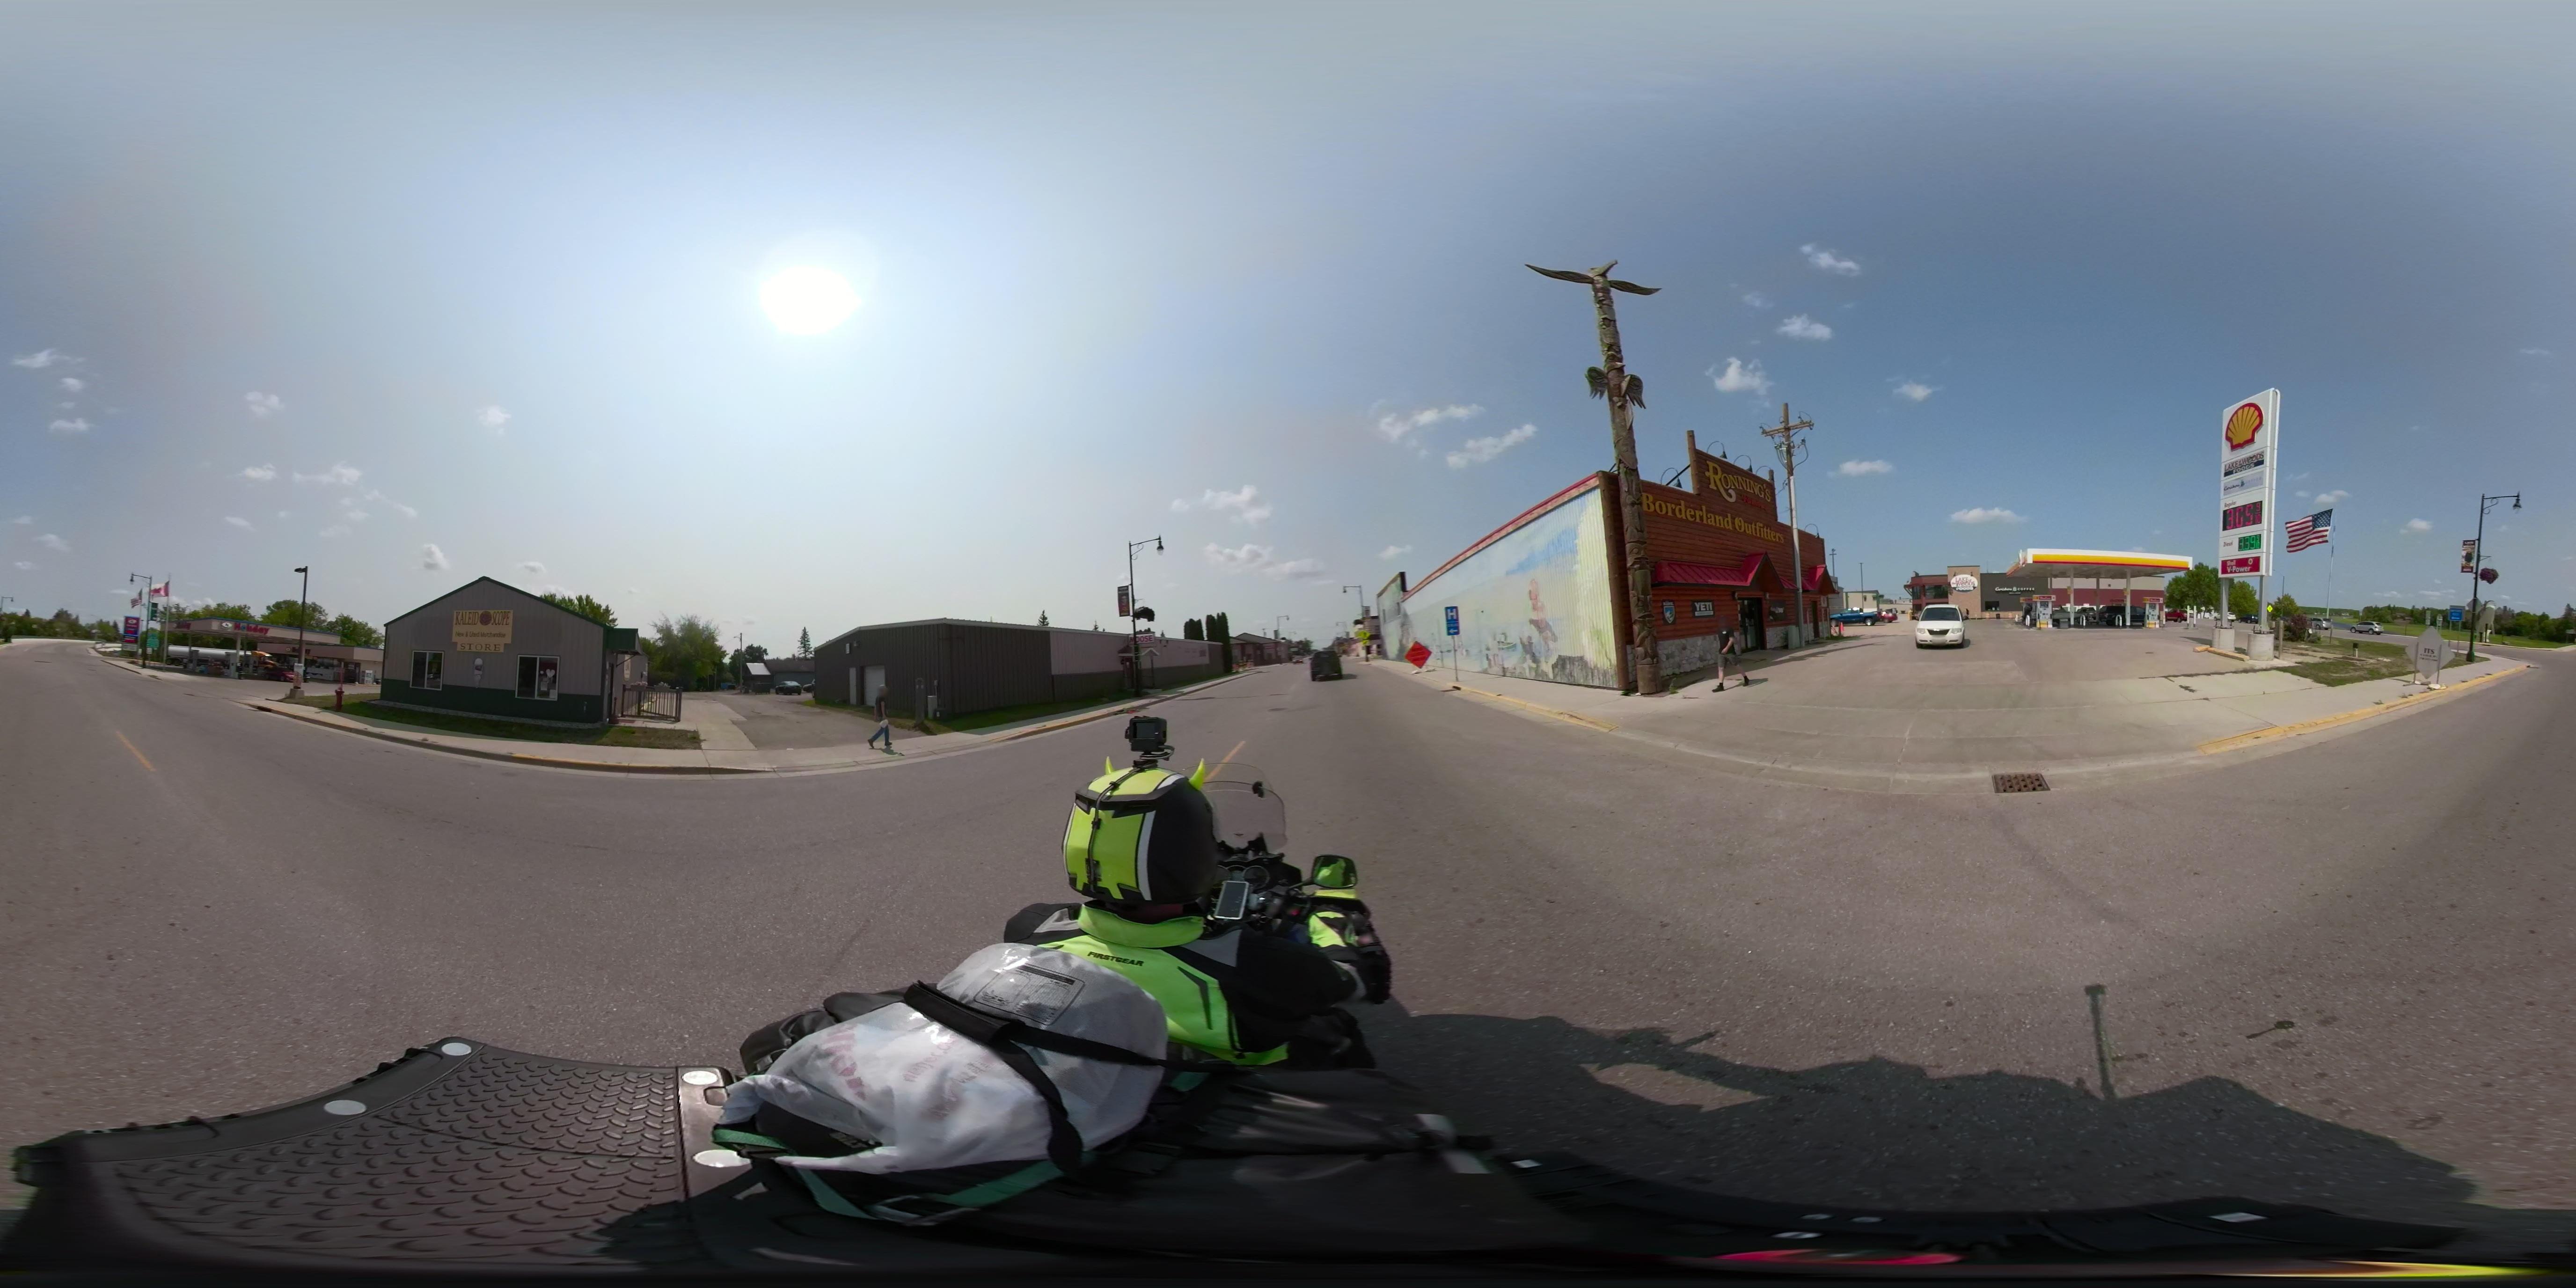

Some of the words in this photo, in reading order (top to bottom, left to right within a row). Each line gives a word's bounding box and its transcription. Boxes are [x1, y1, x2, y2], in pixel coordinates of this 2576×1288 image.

[1642, 493, 1731, 529] Borderland
[1735, 517, 1785, 543] Outfitters
[1695, 602, 1713, 611] YETI
[1447, 608, 1457, 620] H
[1087, 951, 1145, 966] FIRSTGEAR
